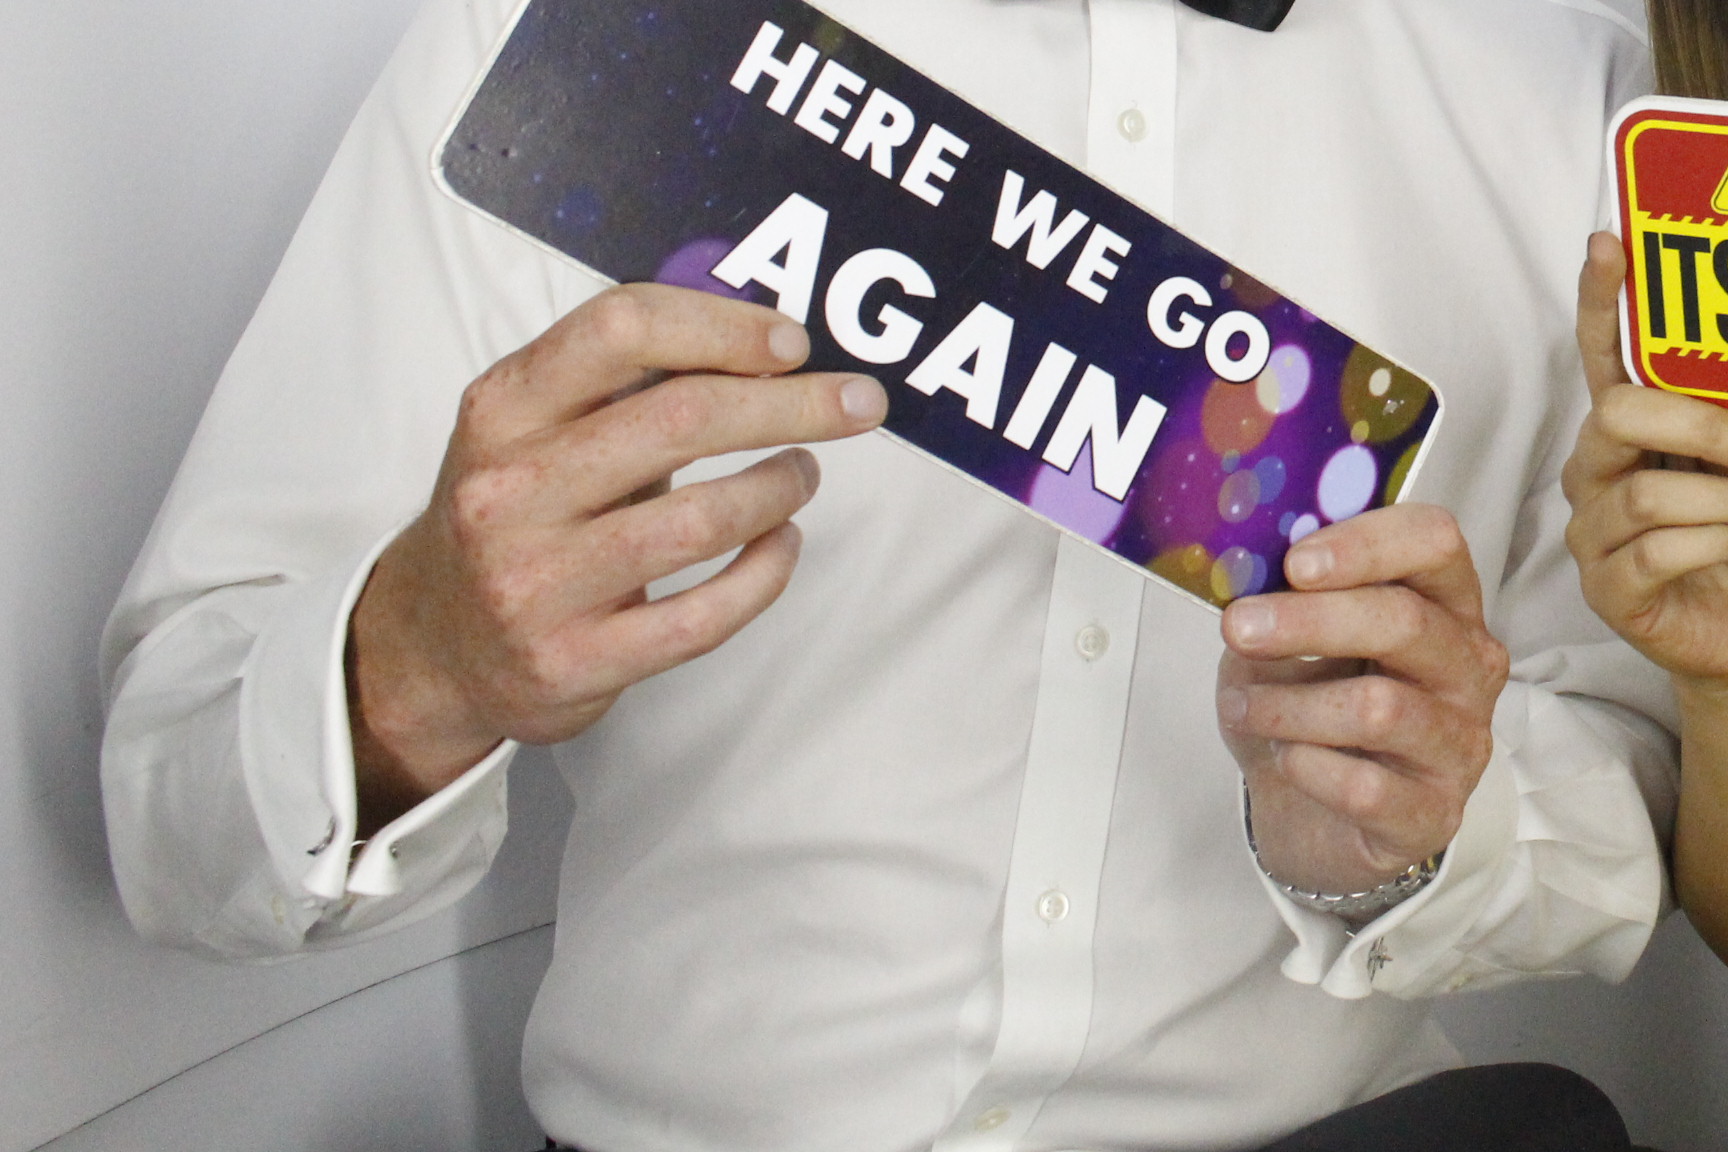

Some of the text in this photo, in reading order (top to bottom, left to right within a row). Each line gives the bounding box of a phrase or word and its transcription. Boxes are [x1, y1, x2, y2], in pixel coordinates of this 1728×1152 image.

[710, 192, 1166, 503] AGAIN
[729, 20, 1271, 382] HERE WE GO
